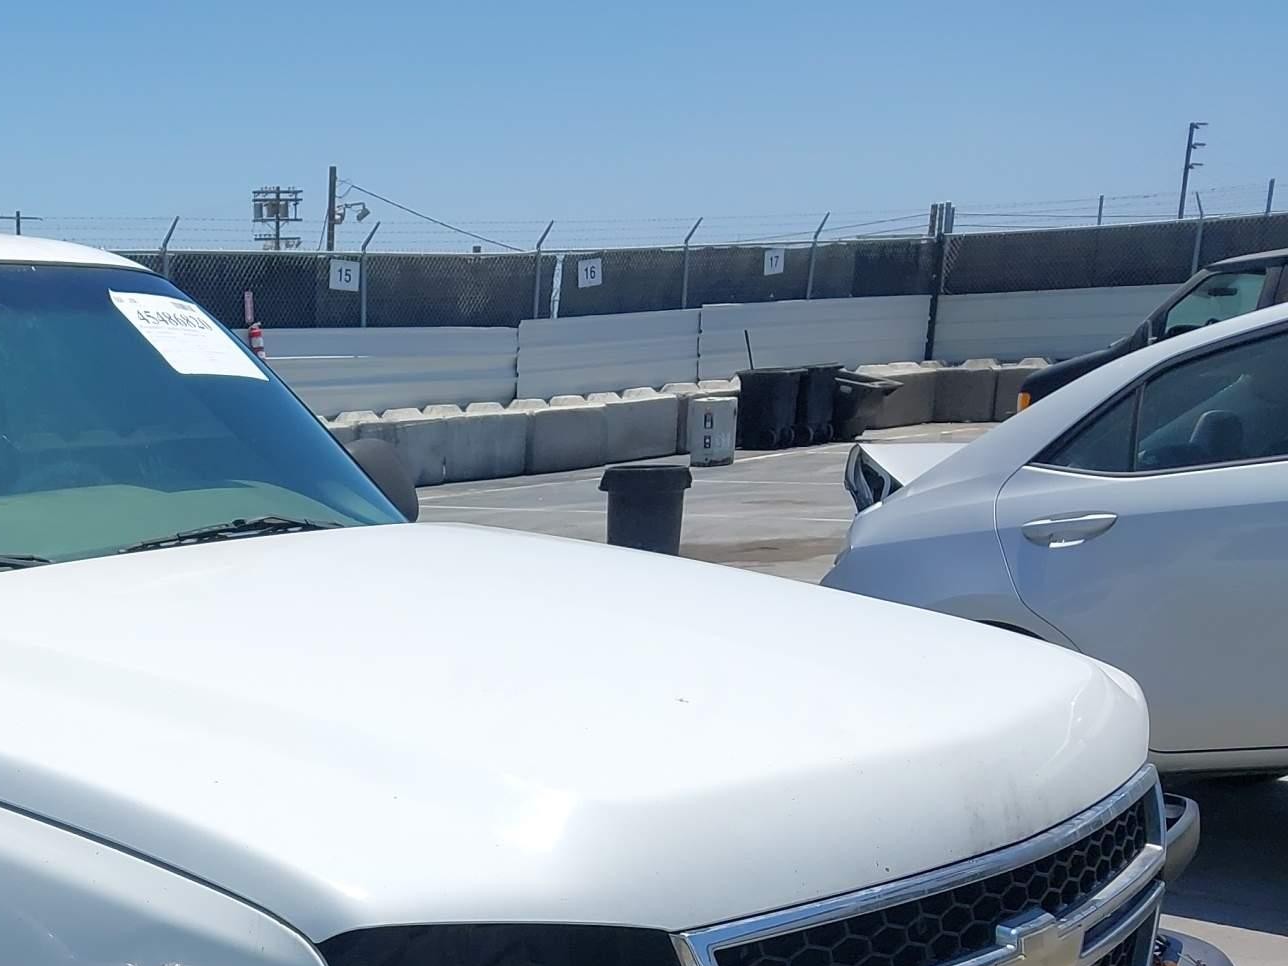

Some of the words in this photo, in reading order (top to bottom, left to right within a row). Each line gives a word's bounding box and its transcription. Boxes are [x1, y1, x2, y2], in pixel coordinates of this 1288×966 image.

[770, 255, 780, 269] 17
[338, 267, 352, 283] 15
[584, 265, 596, 280] 16
